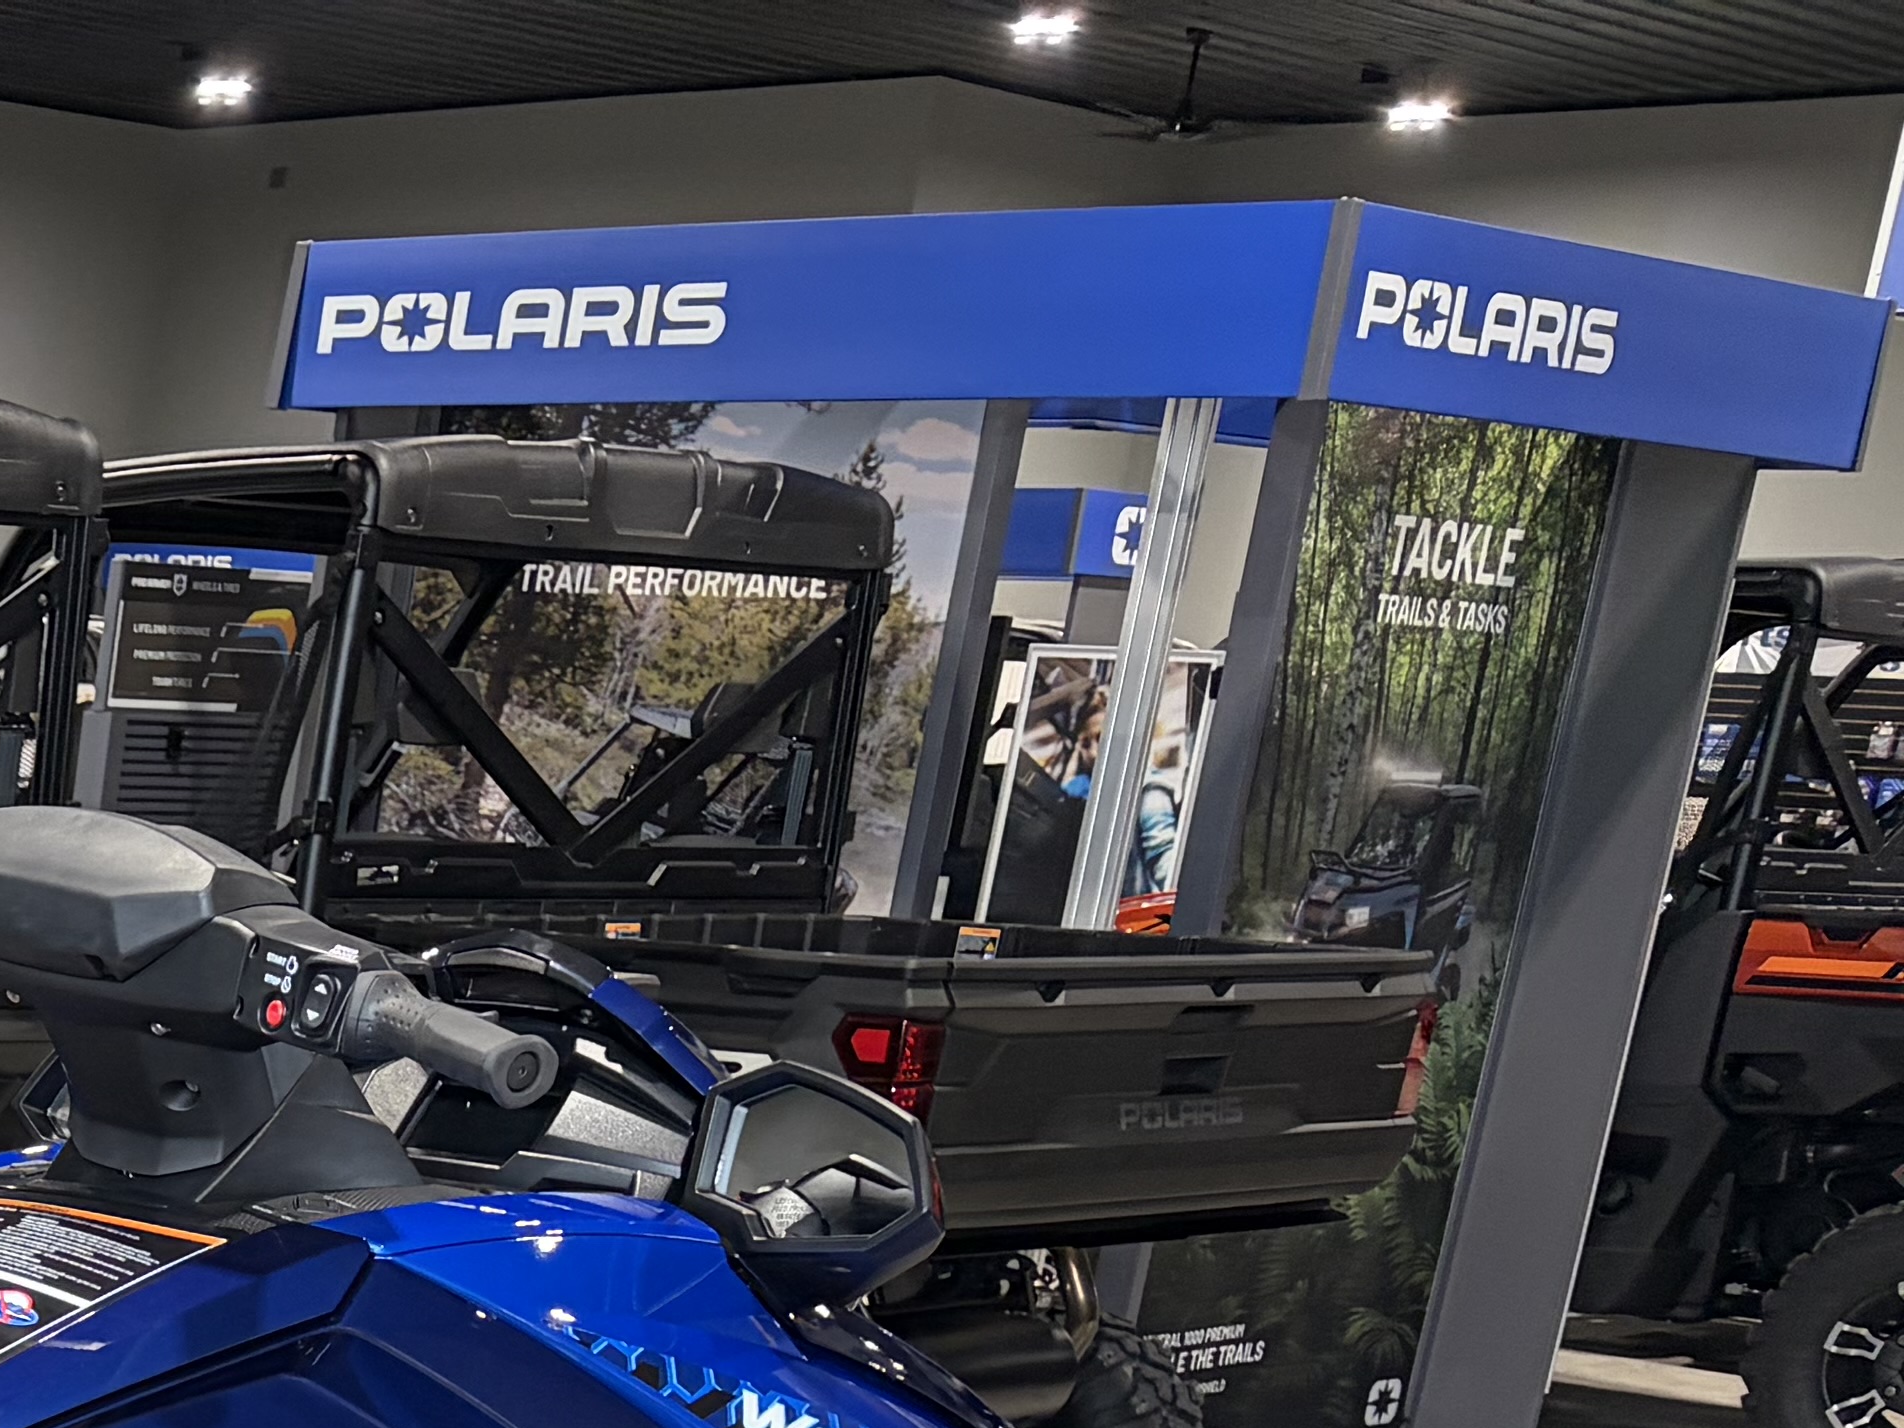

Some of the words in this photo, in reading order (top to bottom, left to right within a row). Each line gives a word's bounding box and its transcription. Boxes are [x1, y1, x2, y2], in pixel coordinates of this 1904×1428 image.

[316, 281, 728, 354] POLARIS
[1356, 270, 1619, 375] POLARIS
[1392, 514, 1525, 588] TACKLE
[521, 563, 600, 595] TRAIL
[607, 564, 828, 600] PERFORMANCE
[1377, 593, 1438, 628] TRAILS
[1438, 598, 1452, 628] &
[1456, 601, 1509, 634] TASKS
[1119, 1098, 1243, 1131] POLARIS
[1191, 1347, 1217, 1371] THE
[1219, 1340, 1266, 1367] TRAILS
